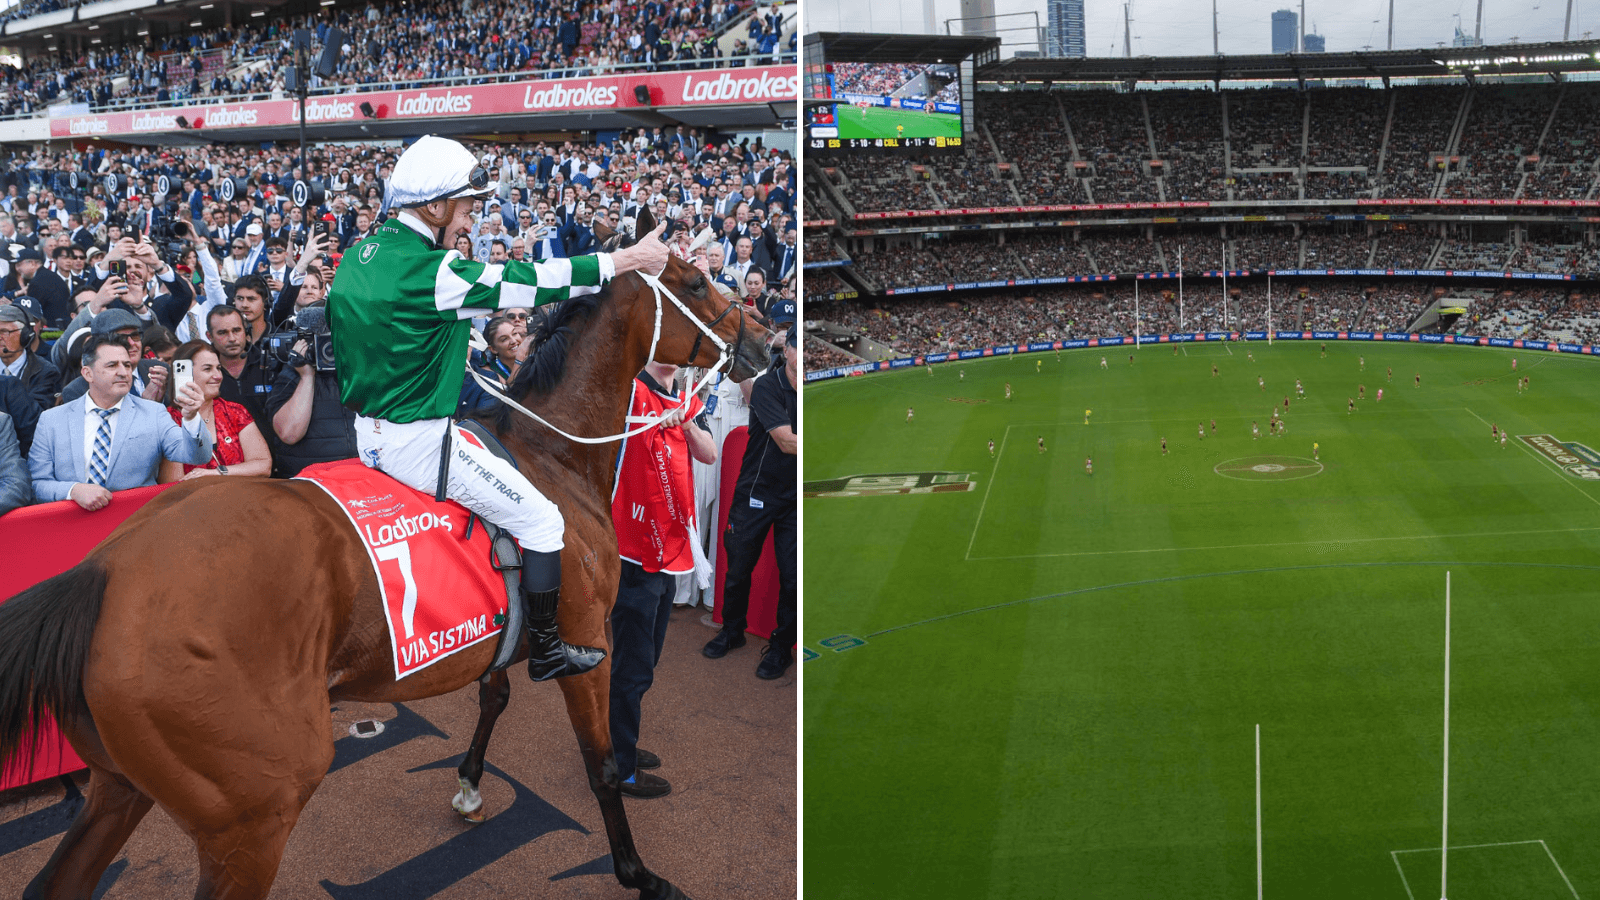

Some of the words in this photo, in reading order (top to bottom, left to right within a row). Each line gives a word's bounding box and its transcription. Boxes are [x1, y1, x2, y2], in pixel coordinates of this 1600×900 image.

[524, 82, 618, 109] Ladbrokes
[682, 70, 797, 102] Ladbrokes
[396, 90, 472, 116] Ladbrokes
[69, 117, 108, 135] Ladbrokes
[132, 112, 176, 131] Ladbrokes
[204, 106, 258, 127] Ladbrokes
[110, 176, 115, 188] 5
[160, 180, 167, 191] 4
[224, 182, 231, 196] 3
[296, 186, 304, 201] 2
[807, 370, 835, 381] CHEMIST
[656, 450, 666, 471] PLATE
[458, 450, 476, 466] OFF
[474, 464, 495, 482] THE
[492, 478, 524, 504] TRACK
[660, 472, 669, 484] COX
[664, 485, 676, 520] LADBROKES
[374, 540, 418, 640] 7
[400, 638, 430, 666] VIA
[428, 614, 487, 654] SISTINA
